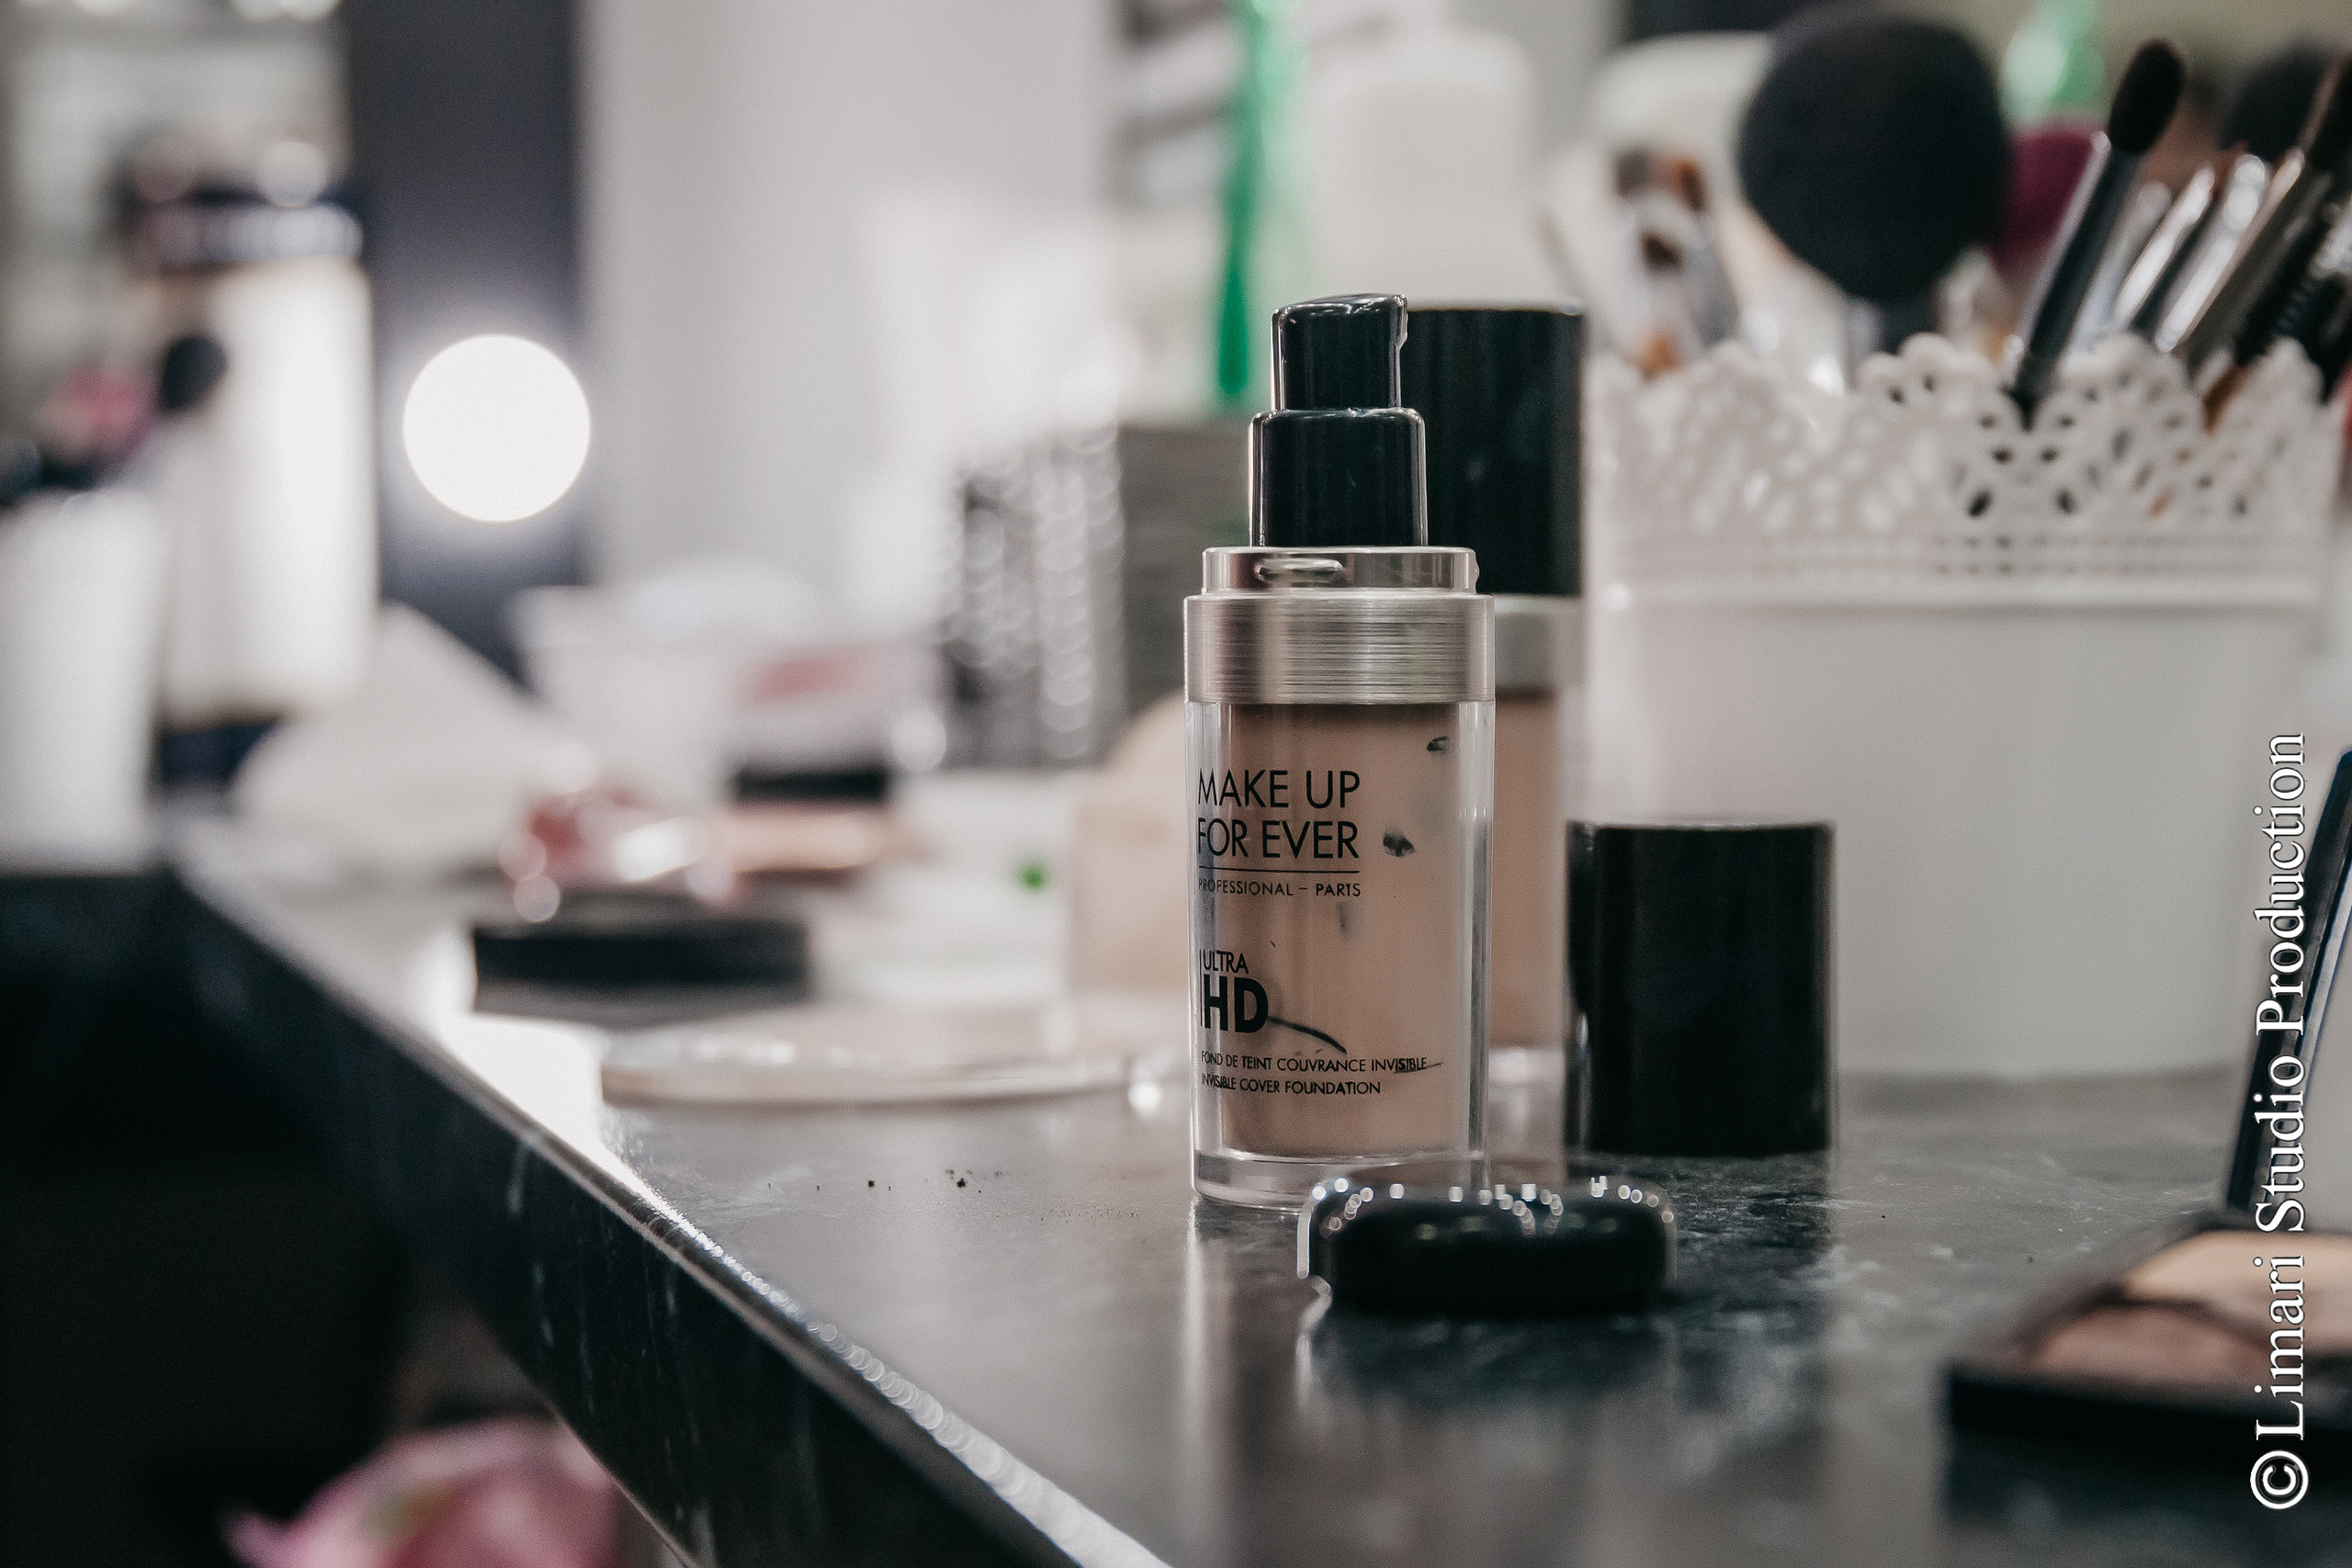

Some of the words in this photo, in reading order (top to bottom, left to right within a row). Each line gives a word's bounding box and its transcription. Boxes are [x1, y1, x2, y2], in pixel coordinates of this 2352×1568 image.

[1198, 768, 1289, 808] MAKE
[1306, 770, 1361, 809] UP
[1197, 818, 1250, 858] FOR
[1261, 819, 1360, 860] EVER
[1198, 877, 1294, 897] PROFESSIONAL
[1315, 882, 1362, 897] PARIS
[1203, 949, 1250, 975] ULTRA
[1204, 974, 1269, 1034] HD
[1201, 1051, 1224, 1066] FOND
[1226, 1055, 1238, 1068] DE
[1241, 1056, 1272, 1071] TEINT
[1276, 1057, 1366, 1072] COUVRANCE
[1371, 1056, 1427, 1072] INVISIBLE
[1201, 1073, 1237, 1091] INVISIBLE
[1239, 1077, 1280, 1093] COVER
[1285, 1080, 1381, 1095] FOUNDATION
